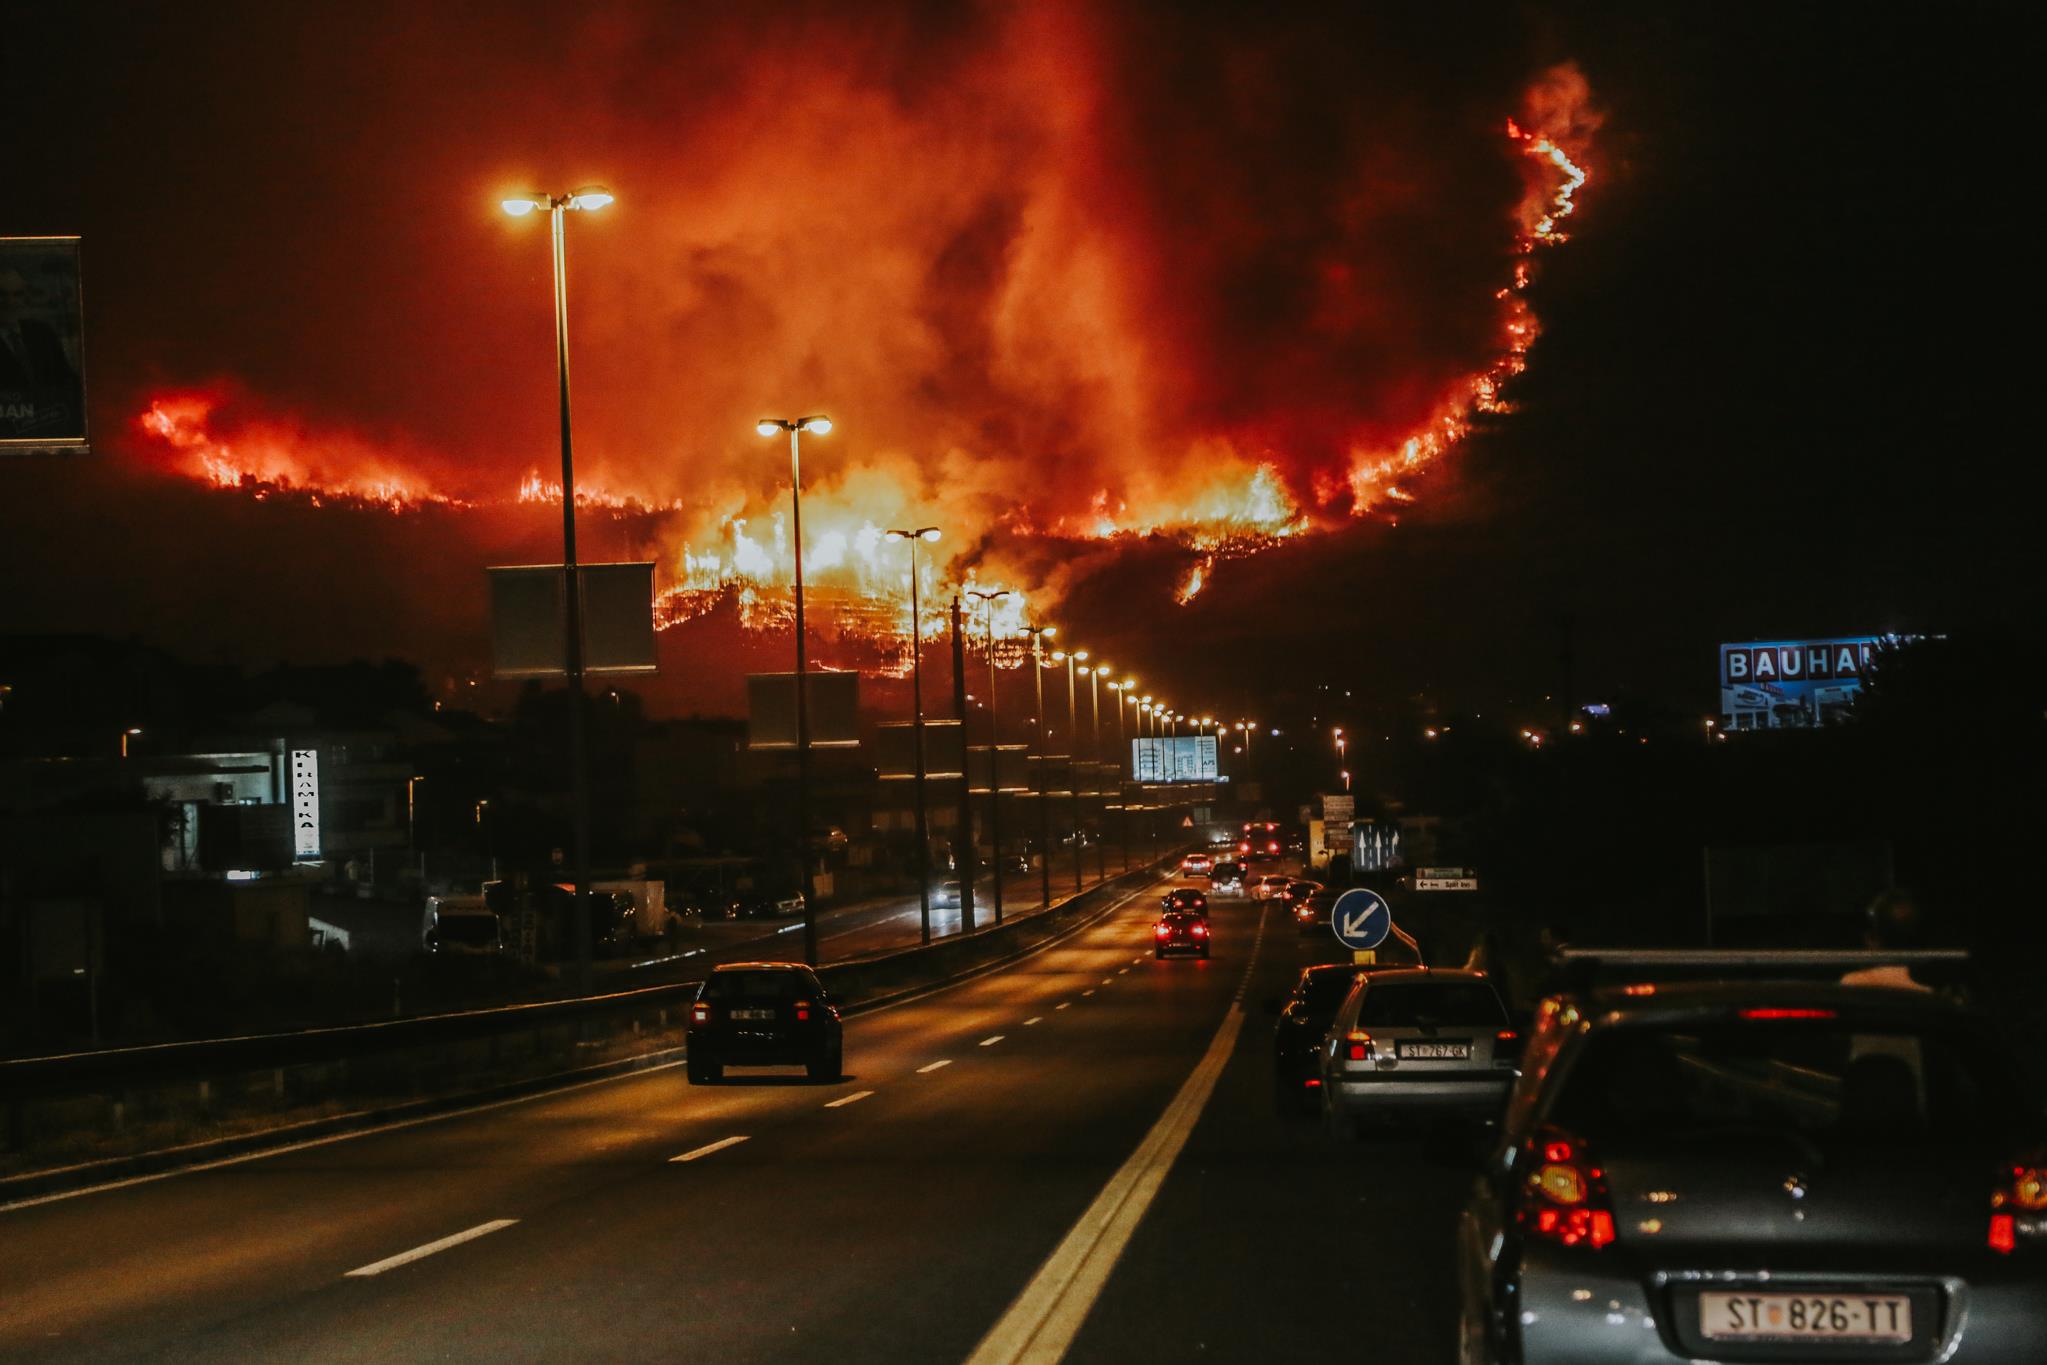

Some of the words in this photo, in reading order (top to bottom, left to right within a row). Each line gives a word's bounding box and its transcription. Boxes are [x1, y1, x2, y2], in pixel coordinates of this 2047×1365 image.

[295, 751, 314, 828] KERAMIKA
[1726, 1298, 1762, 1329] ST
[1788, 1300, 1899, 1331] 826-TT
